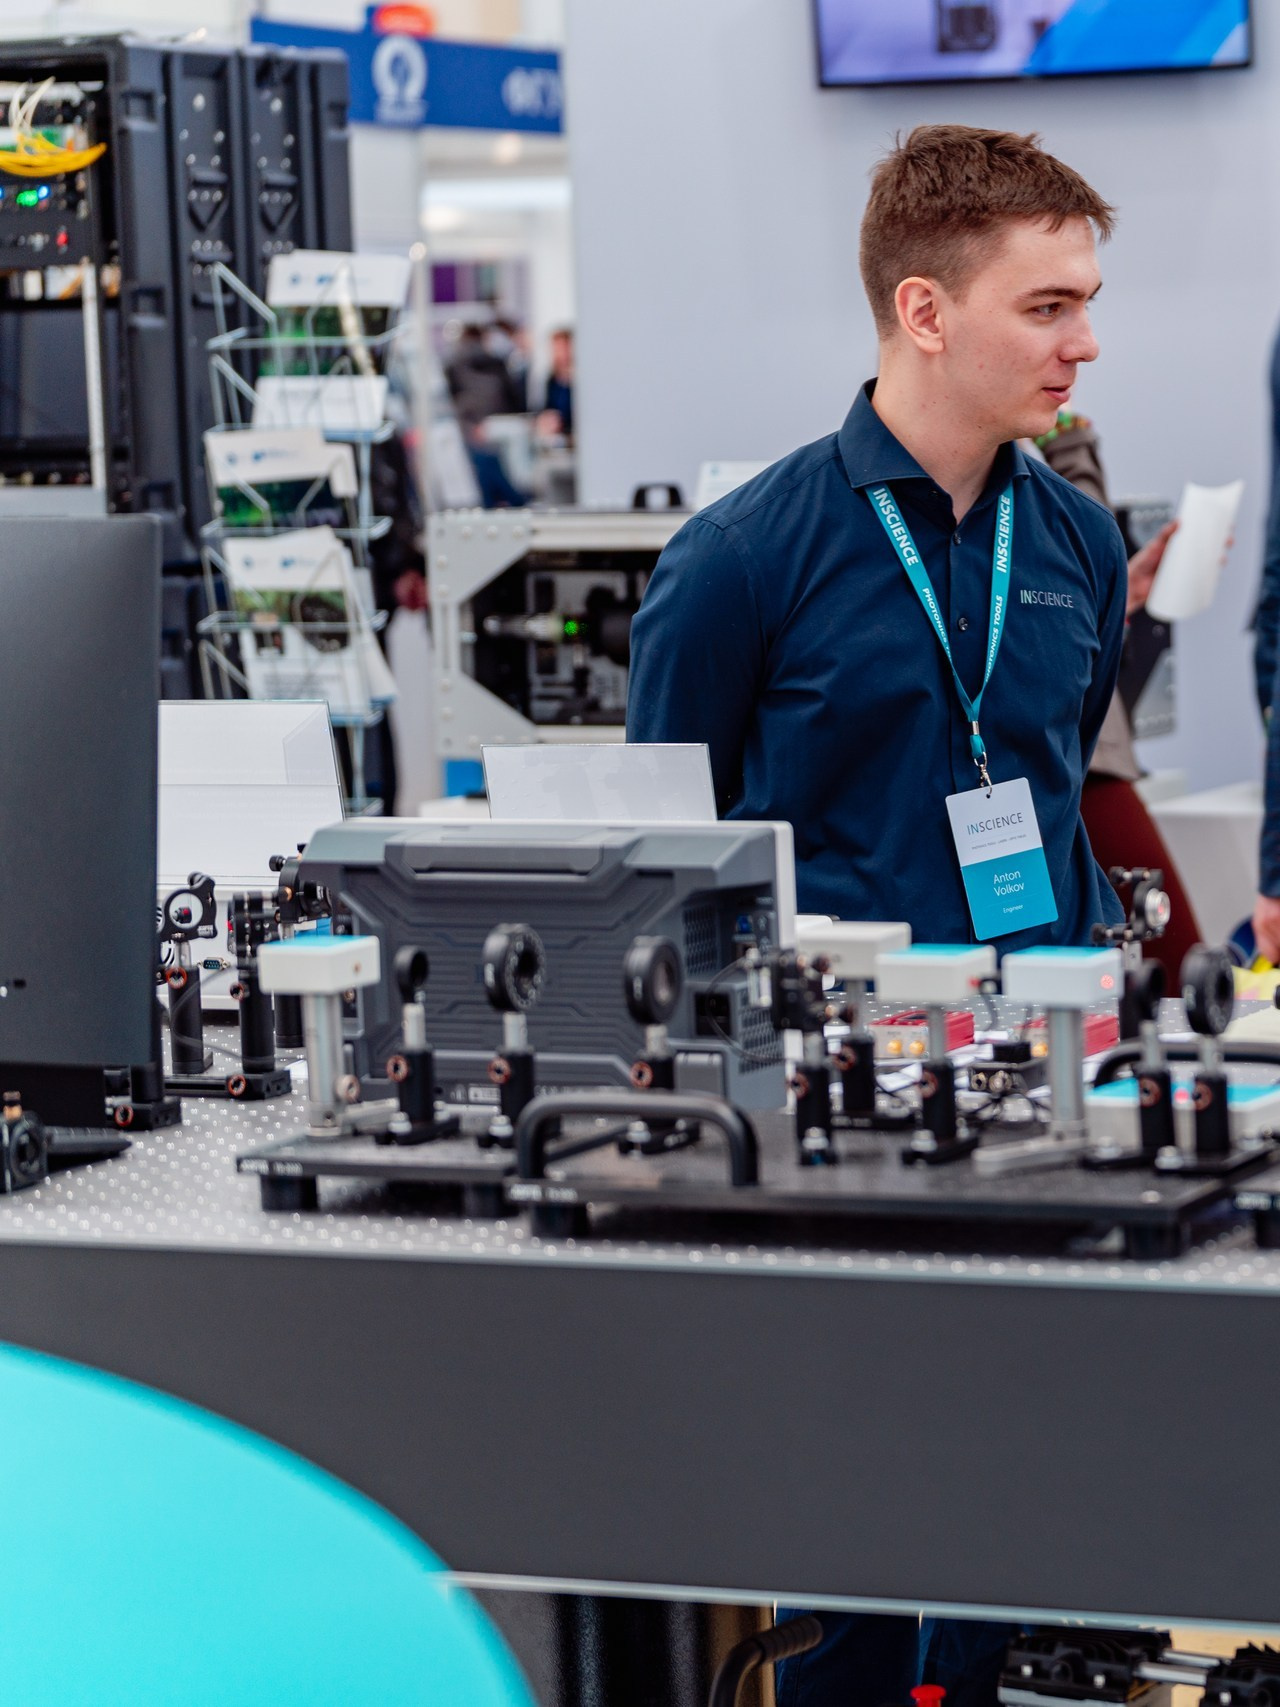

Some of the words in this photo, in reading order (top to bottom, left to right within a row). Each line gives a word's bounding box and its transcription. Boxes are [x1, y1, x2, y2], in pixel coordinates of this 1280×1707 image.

[873, 488, 919, 567] INSCIENCE
[996, 495, 1011, 573] INSCIENCE
[994, 595, 1004, 625] TOOLS
[1020, 589, 1074, 609] INSCIENCE
[922, 588, 947, 643] PHOTONICS
[966, 812, 1024, 835] INSCIENCE
[993, 870, 1021, 884] Anton
[993, 882, 1025, 896] Volkov
